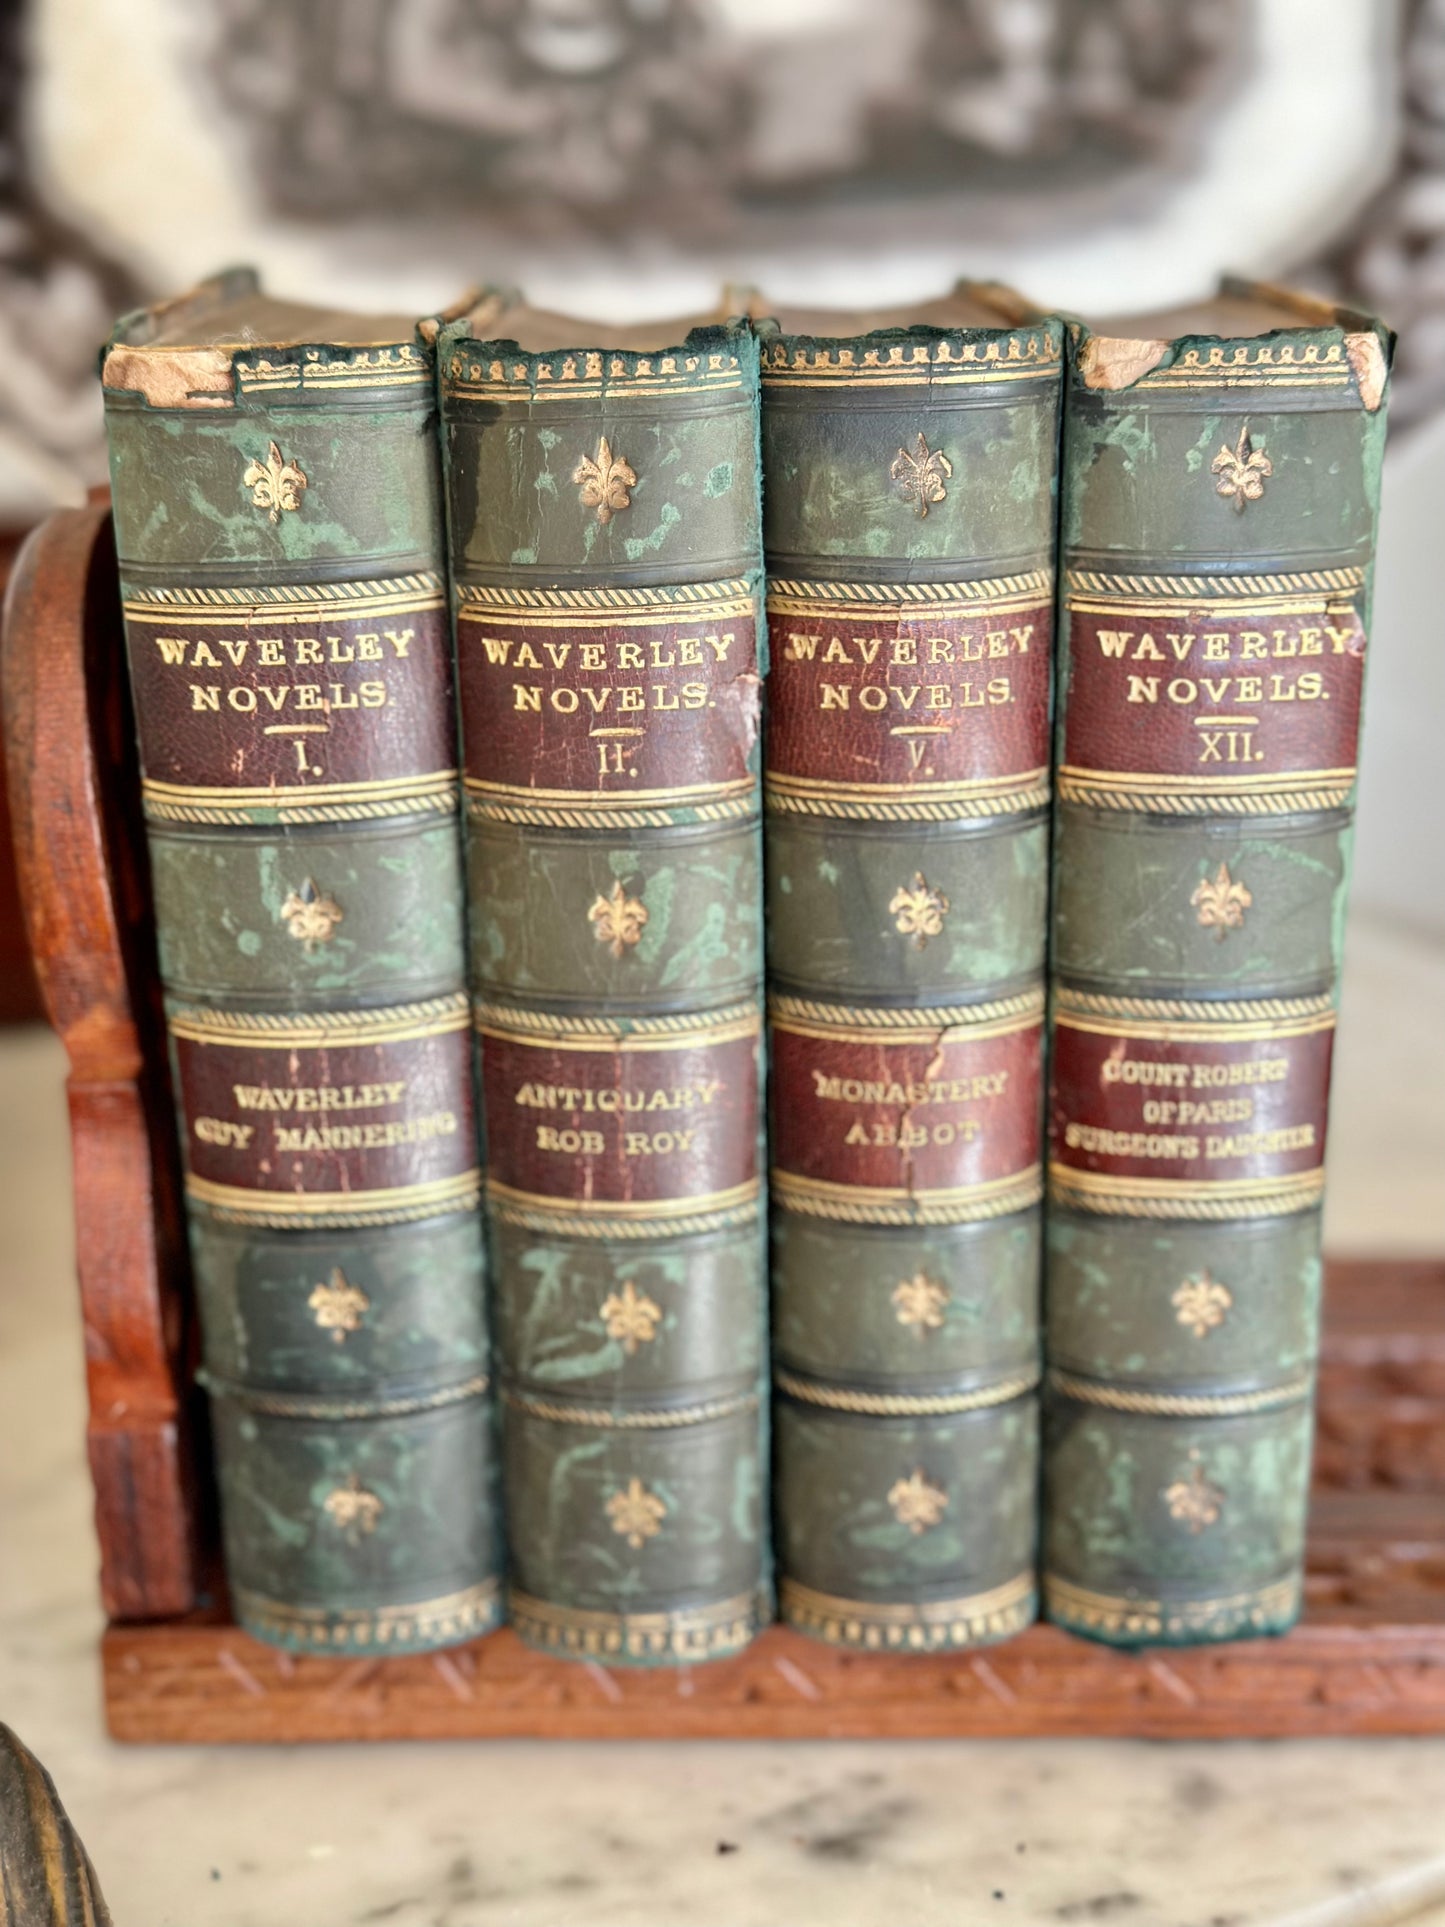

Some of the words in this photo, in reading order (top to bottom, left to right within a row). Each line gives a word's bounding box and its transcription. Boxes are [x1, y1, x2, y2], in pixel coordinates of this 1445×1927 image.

[156, 629, 415, 666] WAVERLEY
[481, 633, 735, 670] WAVERLEY
[787, 625, 1034, 664] WAVERLEY
[1096, 626, 1354, 661] WAVERLEY
[512, 682, 716, 713] NOVELS.
[819, 678, 1016, 711] NOVELS.
[1127, 673, 1331, 704] NOVELS.
[293, 740, 323, 777] I.
[597, 743, 638, 778] II.
[908, 740, 934, 776] V.
[1199, 732, 1264, 762] XII.
[812, 1070, 1008, 1104] MONASTERY
[1102, 1058, 1190, 1087] COUNT
[1191, 1059, 1289, 1088] ROBERT
[233, 1081, 405, 1112] WAVERLEY
[515, 1081, 720, 1112] ANTIQUARY
[1142, 1101, 1176, 1124] OF
[1177, 1099, 1252, 1125] PARIS
[194, 1116, 254, 1149] GUY
[536, 1125, 605, 1154] ROB
[626, 1129, 697, 1155] ROY
[845, 1121, 980, 1147] ABBOT
